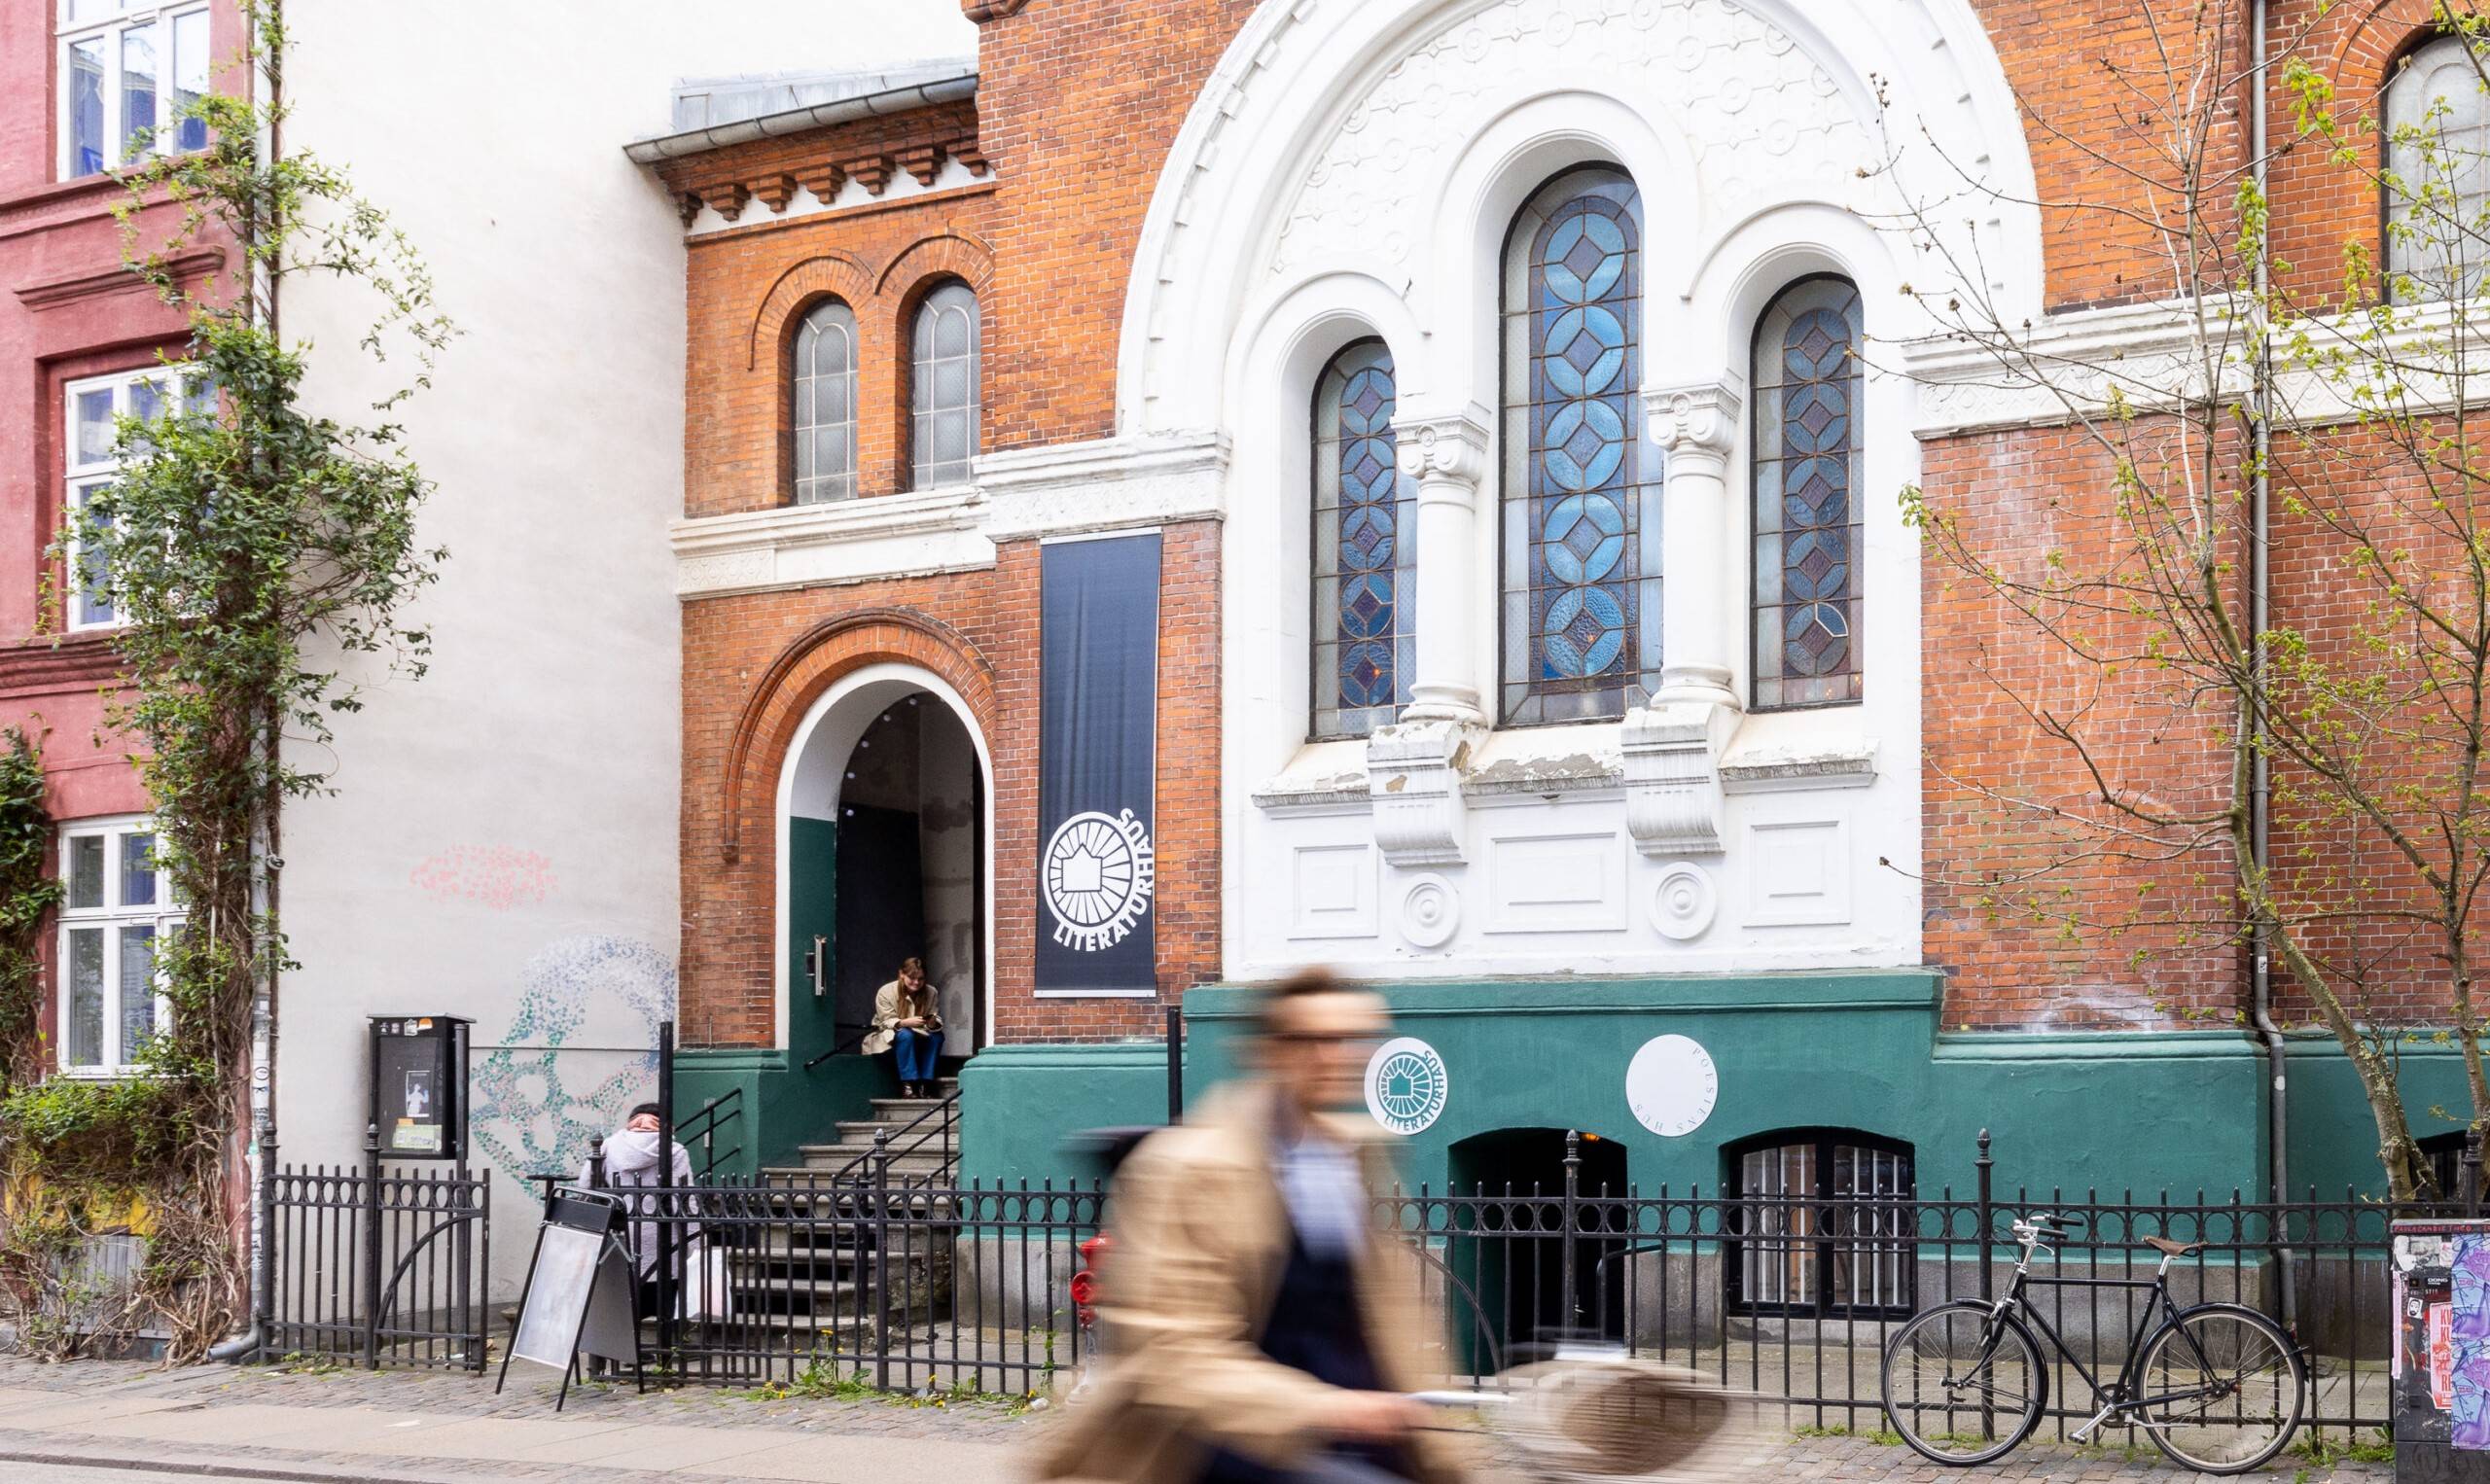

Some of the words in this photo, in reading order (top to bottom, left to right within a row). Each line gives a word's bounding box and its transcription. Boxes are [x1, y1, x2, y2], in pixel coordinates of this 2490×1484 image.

[1053, 807, 1154, 951] LITERATURHAUS
[1384, 1050, 1444, 1131] LITERATURHAUS
[1634, 1104, 1664, 1132] HUS
[1676, 1047, 1714, 1132] POESIENS
